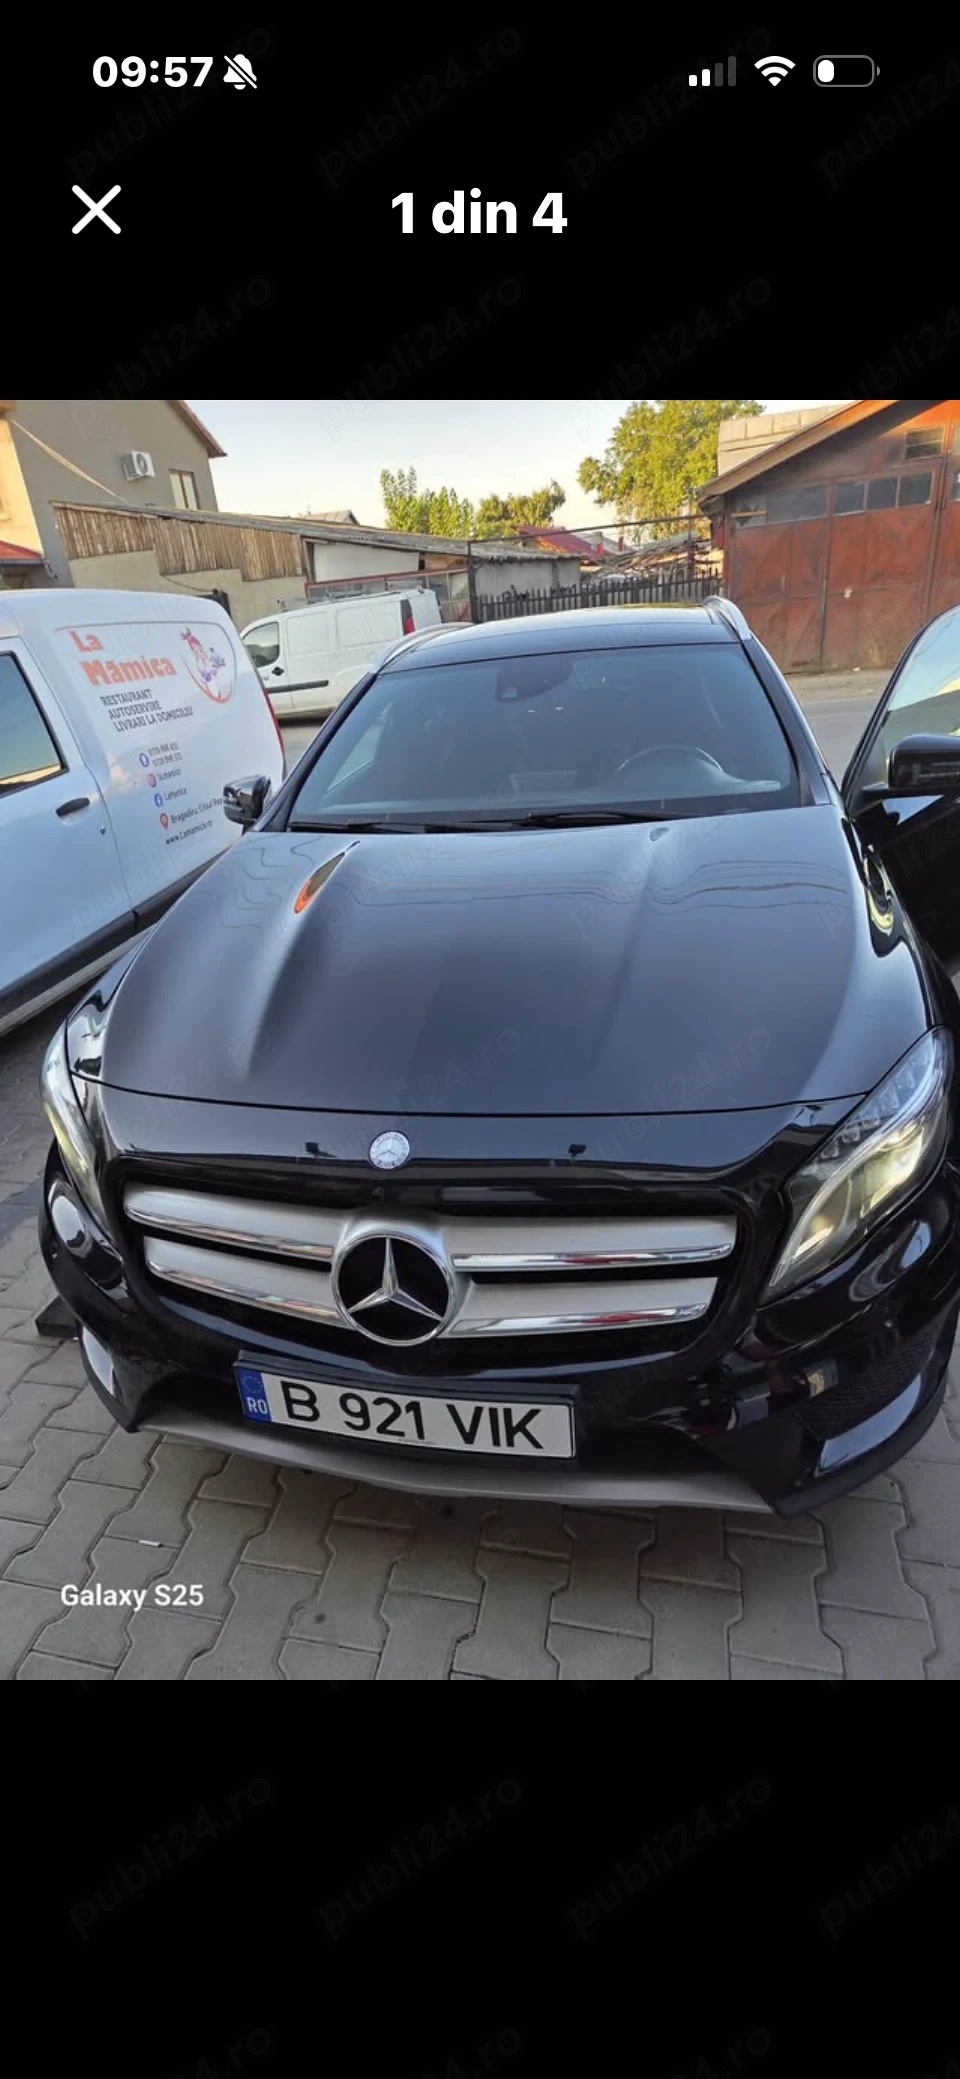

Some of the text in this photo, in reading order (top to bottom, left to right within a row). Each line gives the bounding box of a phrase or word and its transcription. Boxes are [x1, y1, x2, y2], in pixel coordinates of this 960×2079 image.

[70, 630, 102, 653] La
[100, 689, 152, 706] RESTAURANT
[108, 700, 162, 720] AUTOSERVIRE
[113, 706, 194, 732] LIVRARI LA DOMICILIU
[247, 1396, 268, 1415] RO
[280, 1381, 543, 1449] B 921 VIK
